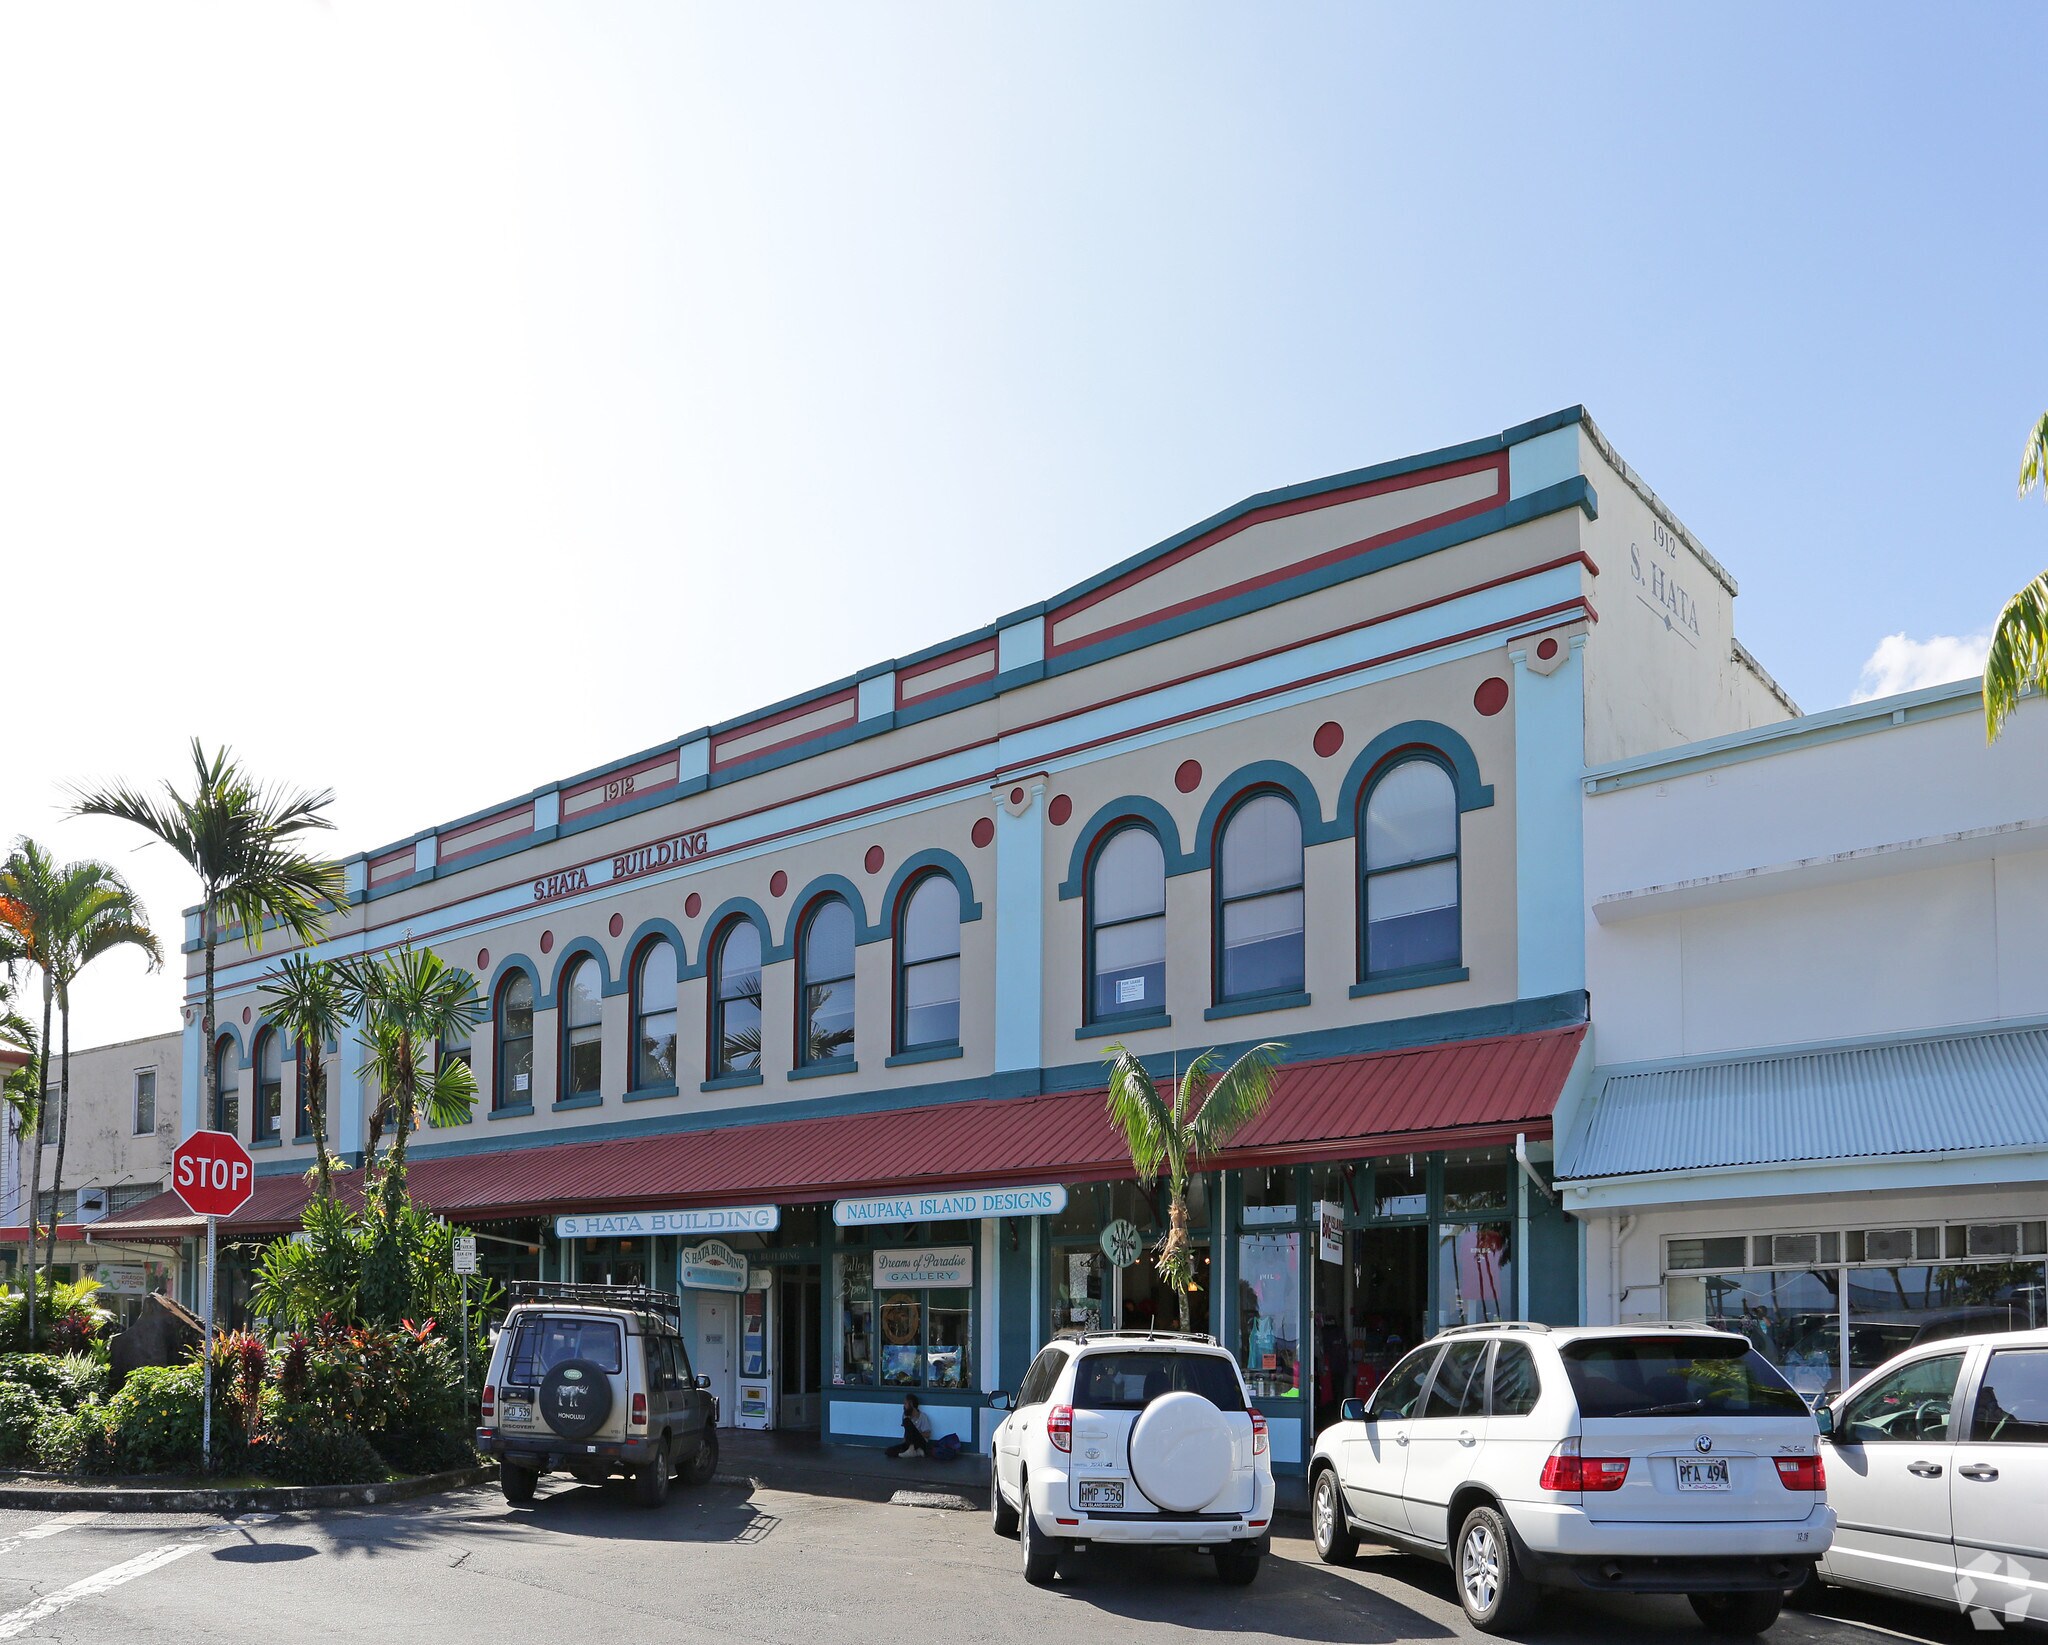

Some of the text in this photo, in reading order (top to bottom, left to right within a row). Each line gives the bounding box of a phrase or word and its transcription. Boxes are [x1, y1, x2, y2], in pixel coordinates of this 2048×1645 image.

[1653, 520, 1675, 559] 1912
[1651, 560, 1700, 636] HATA
[603, 776, 634, 802] 1912
[612, 832, 708, 879] BUILDING
[178, 1155, 248, 1190] STOP
[847, 1191, 1052, 1219] NAUPAKA ISLAND DESIGNS
[564, 1210, 770, 1233] S. HATA BUILDING
[455, 1240, 460, 1249] 2
[692, 1245, 710, 1264] HATA
[711, 1244, 744, 1269] BUILDING
[762, 1252, 800, 1260] BUILDING
[879, 1253, 967, 1273] Dreams of Paradise
[891, 1272, 954, 1281] GALLERY
[519, 1408, 531, 1417] 539
[558, 1412, 585, 1420] HONOLULU
[1680, 1465, 1729, 1482] PFA 494
[1081, 1487, 1122, 1501] HMP 556
